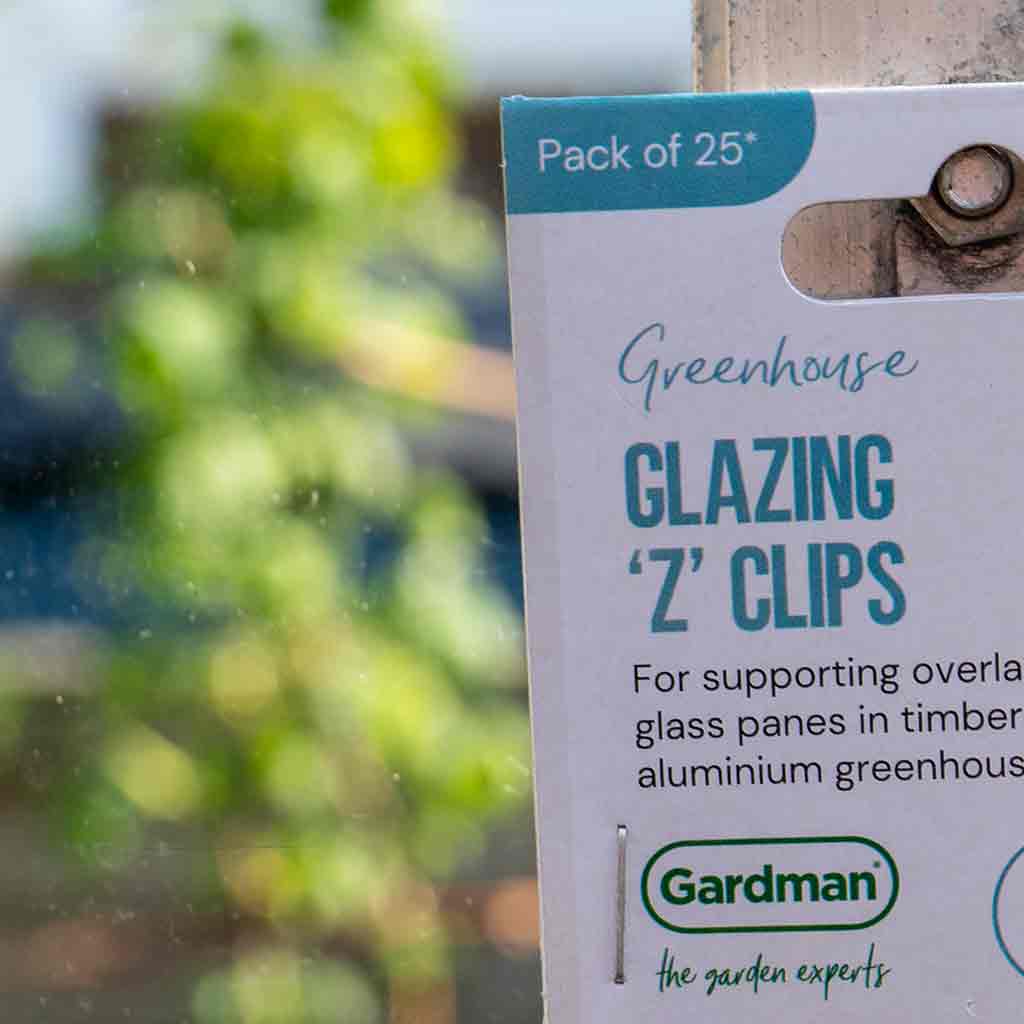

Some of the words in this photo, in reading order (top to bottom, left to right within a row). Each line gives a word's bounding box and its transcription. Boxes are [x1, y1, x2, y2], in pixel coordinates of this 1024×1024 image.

[537, 135, 632, 173] Pack
[643, 132, 681, 168] of
[618, 322, 918, 412] Greenhouse
[624, 434, 896, 528] GLAZING
[731, 541, 906, 632] CLIPS
[633, 662, 690, 693] For
[703, 657, 900, 697] supporting
[635, 710, 725, 749] glass
[738, 708, 846, 745] panes
[860, 706, 889, 734] in
[902, 699, 1022, 732] timber
[638, 757, 822, 788] aluminium
[660, 864, 877, 905] Gardman
[657, 946, 697, 995] the
[704, 955, 787, 995] garden
[797, 942, 891, 1002] experts
